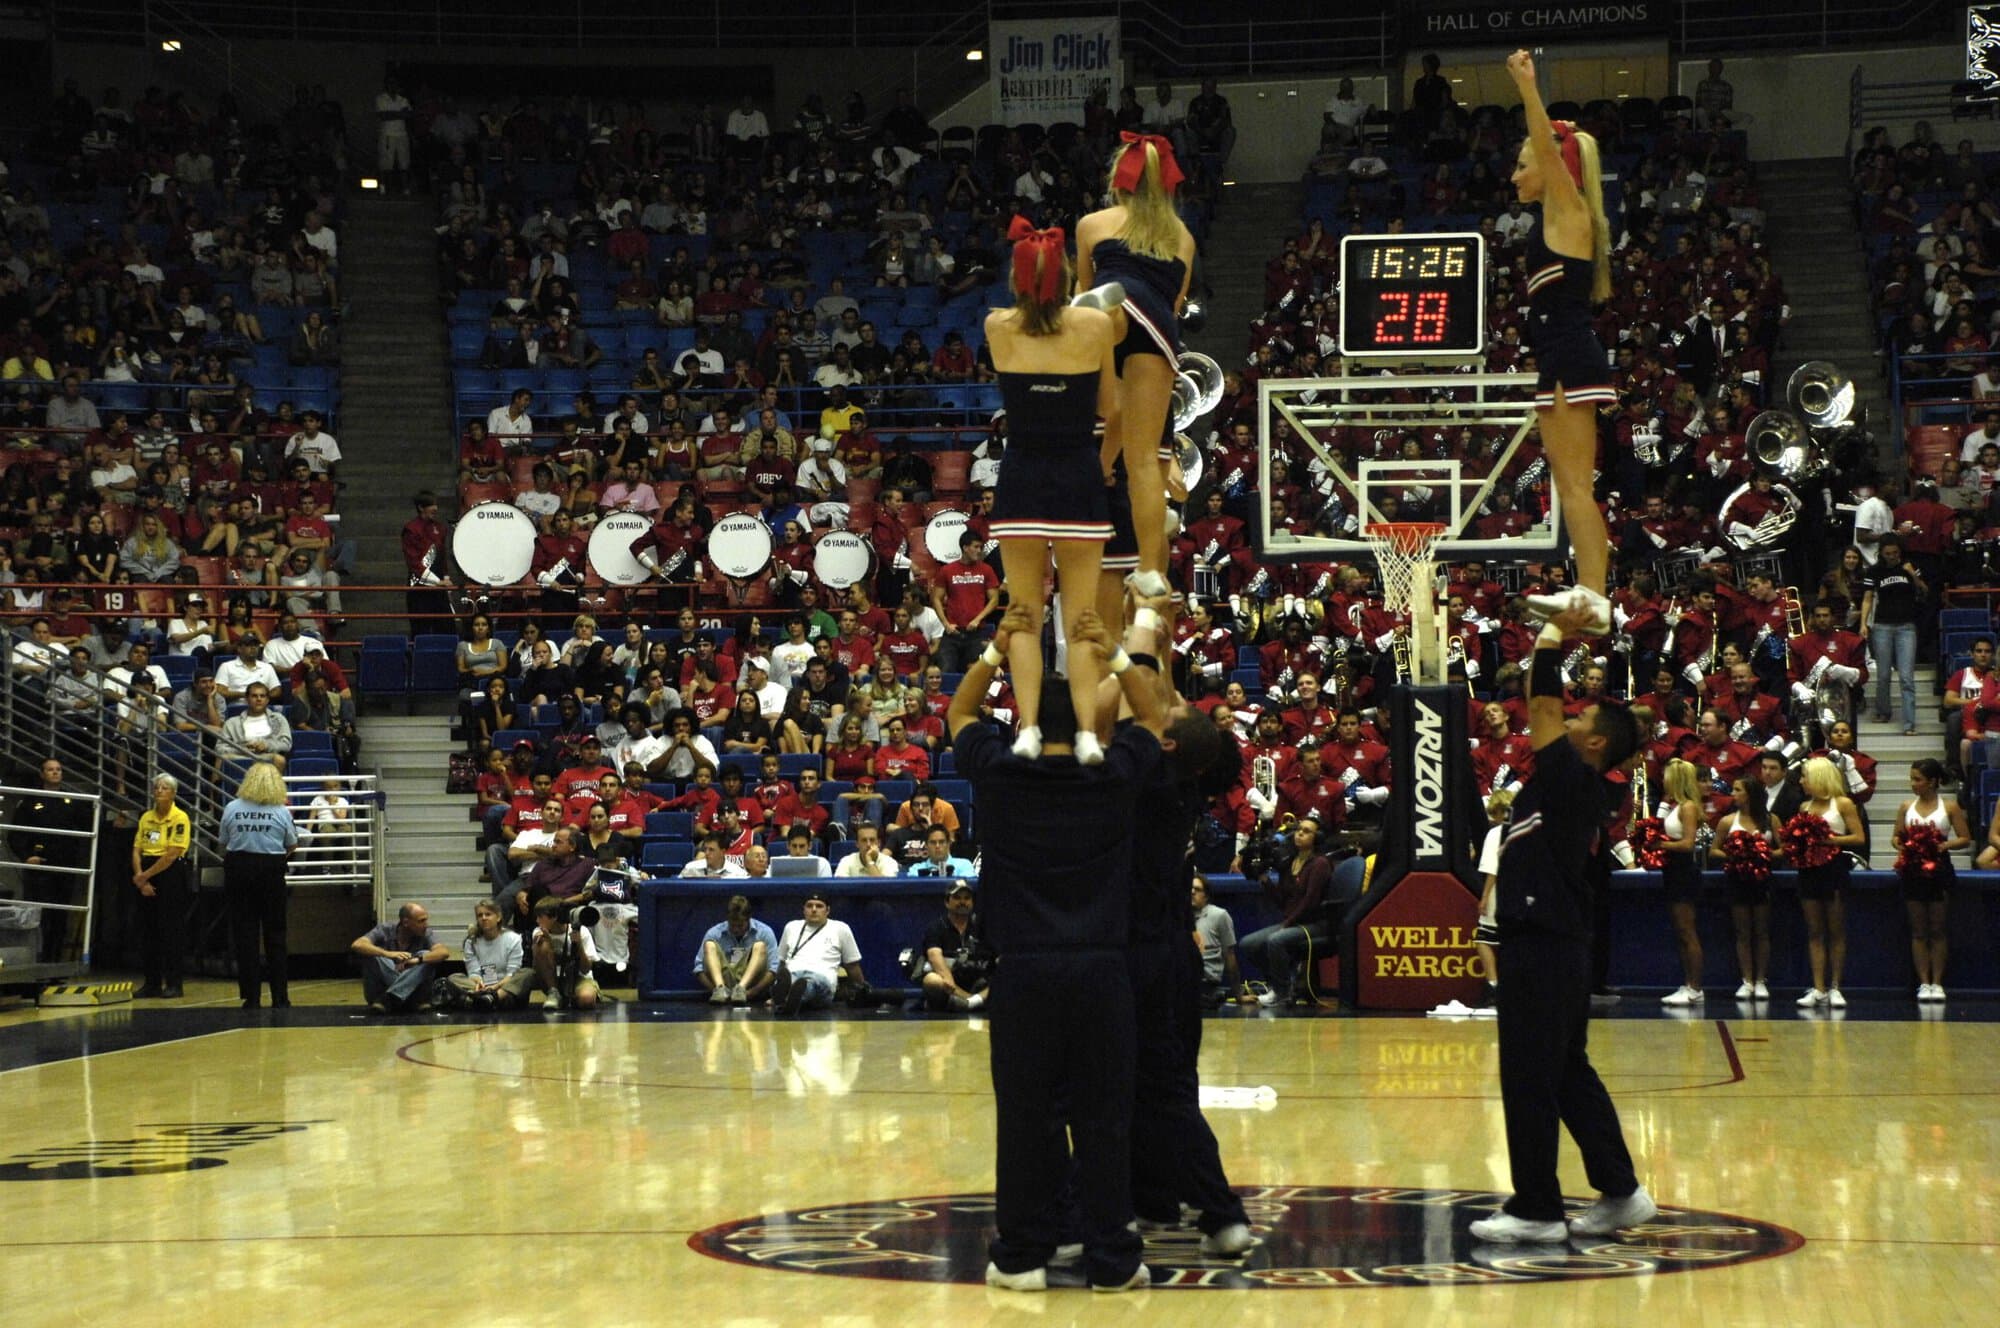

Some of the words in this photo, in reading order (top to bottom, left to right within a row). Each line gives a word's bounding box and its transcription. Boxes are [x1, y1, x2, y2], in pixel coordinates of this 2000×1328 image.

[1426, 13, 1479, 31] HALL
[1487, 11, 1513, 28] OF
[1521, 4, 1648, 26] CHAMPIONS
[1000, 35, 1043, 74] Jim
[1053, 32, 1111, 71] Click
[1371, 246, 1466, 279] 15:26
[1374, 291, 1448, 343] 28
[486, 511, 514, 520] YAMAHA
[615, 521, 643, 530] YAMAHA
[729, 522, 757, 532] YAMAHA
[831, 539, 859, 548] YAMAHA
[104, 592, 124, 610] 19
[1414, 698, 1443, 857] ARIZONA
[235, 811, 273, 820] EVENT
[237, 824, 272, 833] STAFF
[1375, 955, 1488, 978] FARGO
